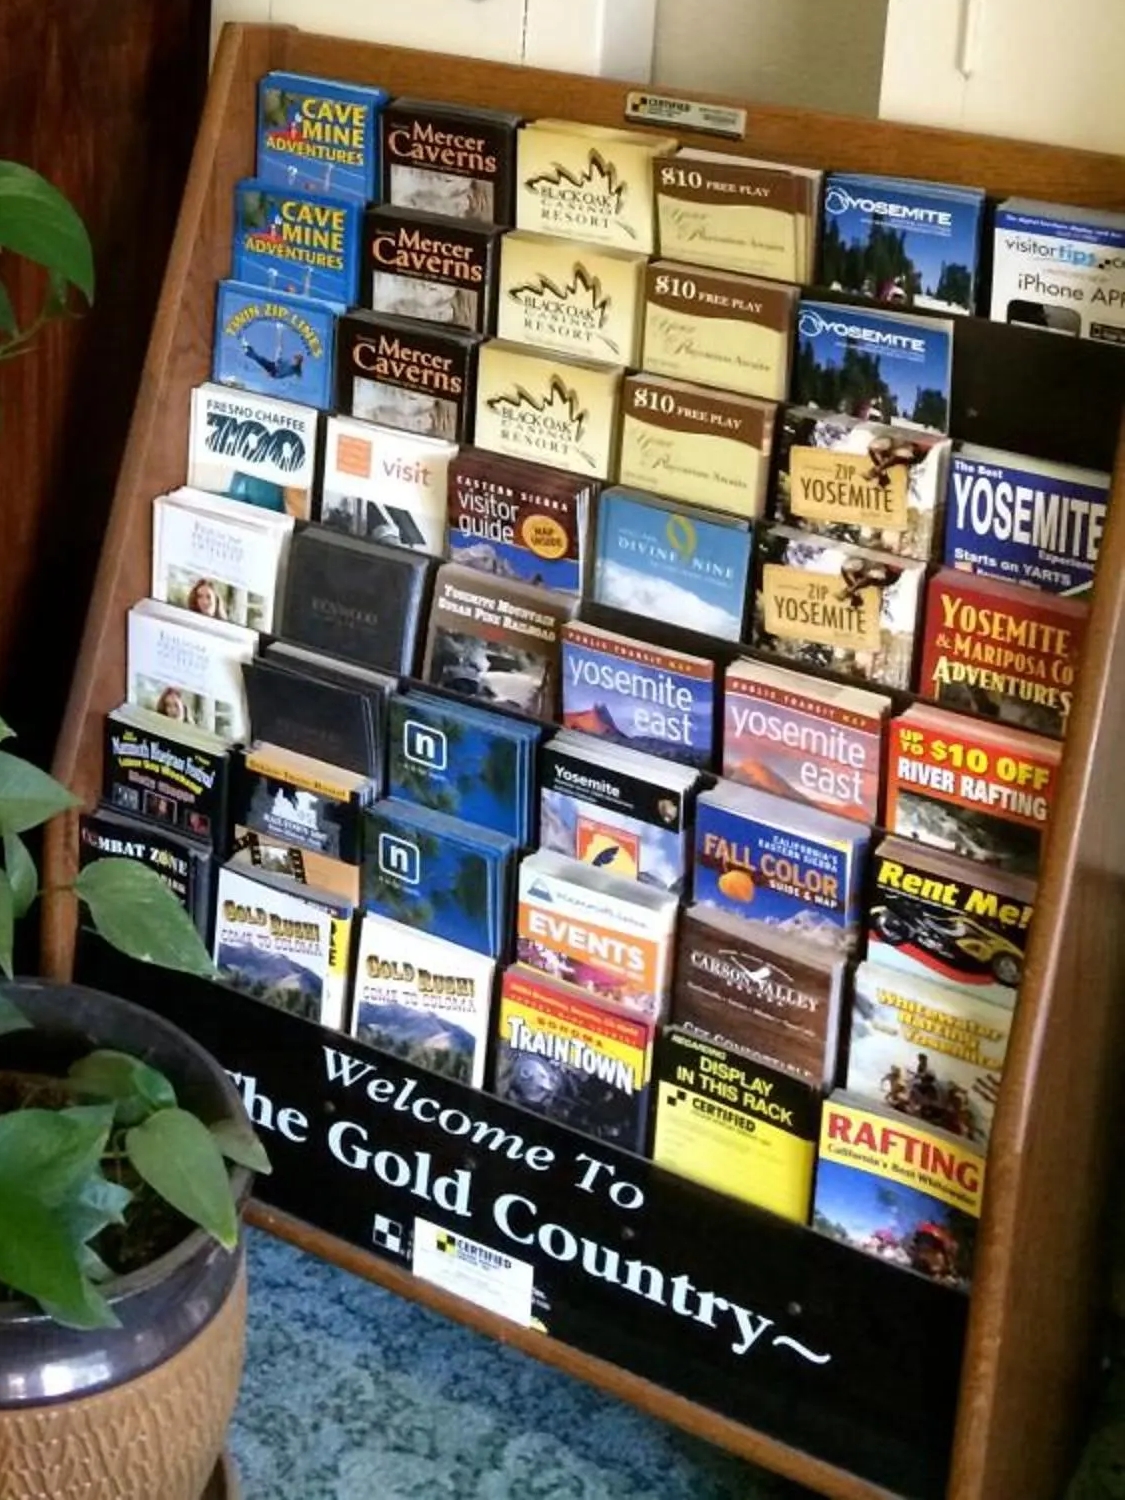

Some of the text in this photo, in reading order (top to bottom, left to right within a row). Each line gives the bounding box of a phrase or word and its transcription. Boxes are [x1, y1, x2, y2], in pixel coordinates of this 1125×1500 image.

[302, 97, 368, 127] CAVE
[266, 136, 364, 165] ADVENTURES
[303, 120, 365, 148] MINE
[388, 130, 497, 173] Caverns
[413, 121, 485, 152] Mercer
[706, 180, 737, 194] FREE
[739, 184, 771, 198] PLAY
[282, 201, 348, 231] CAVE
[846, 198, 952, 226] YOSEMITE
[245, 238, 344, 270] ADVENTURES
[283, 223, 344, 252] MINE
[398, 227, 474, 261] Mercer
[372, 237, 483, 283] Caverns
[698, 291, 729, 307] FREE
[732, 299, 763, 313] PLAY
[1018, 273, 1084, 301] iPhone
[378, 334, 454, 372] Mercer
[820, 323, 926, 352] YOSEMITE
[353, 343, 463, 395] Caverns
[207, 399, 306, 432] FRESNO CHAFFEE
[677, 406, 708, 422] FREE
[710, 414, 742, 429] PLAY
[205, 412, 306, 472] ZOO
[382, 457, 433, 487] visit
[834, 464, 856, 482] ZIP
[954, 460, 976, 474] The
[457, 475, 568, 512] EASTERN SIERRA
[457, 487, 520, 523] visitor
[800, 477, 893, 513] YOSEMITE
[458, 513, 515, 544] guide
[953, 473, 1106, 561] YOSEMITE
[954, 548, 998, 567] Starts
[1000, 561, 1019, 573] on
[1023, 563, 1072, 586] YARTS
[808, 583, 829, 601] ZIP
[774, 595, 867, 634] YOSEMITE
[941, 593, 1071, 659] YOSEMITE
[935, 633, 952, 648] &
[953, 632, 1046, 678] MARIPOSA
[568, 656, 694, 711] yosemite
[932, 655, 1074, 717] ADVENTURES
[633, 708, 694, 746] east
[730, 704, 866, 768] yosemite
[900, 729, 924, 744] UP
[554, 764, 621, 798] Yosemite
[900, 737, 1050, 790] TO $10 OFF
[800, 761, 864, 804] east
[897, 757, 1048, 820] RIVER RAFTING
[703, 832, 838, 898] FALL COLOR
[877, 859, 1034, 929] Rent Me!
[529, 909, 645, 971] EVENTS
[690, 950, 751, 989] CARSON
[754, 977, 819, 1012] VALLEY
[700, 1055, 773, 1097] DISPLAY
[677, 1065, 794, 1126] IN THIS RACK
[322, 1045, 645, 1210] Welcome To
[692, 1097, 757, 1133] CERTIFIED
[328, 1121, 471, 1218] Gold
[828, 1112, 979, 1193] RAFTING
